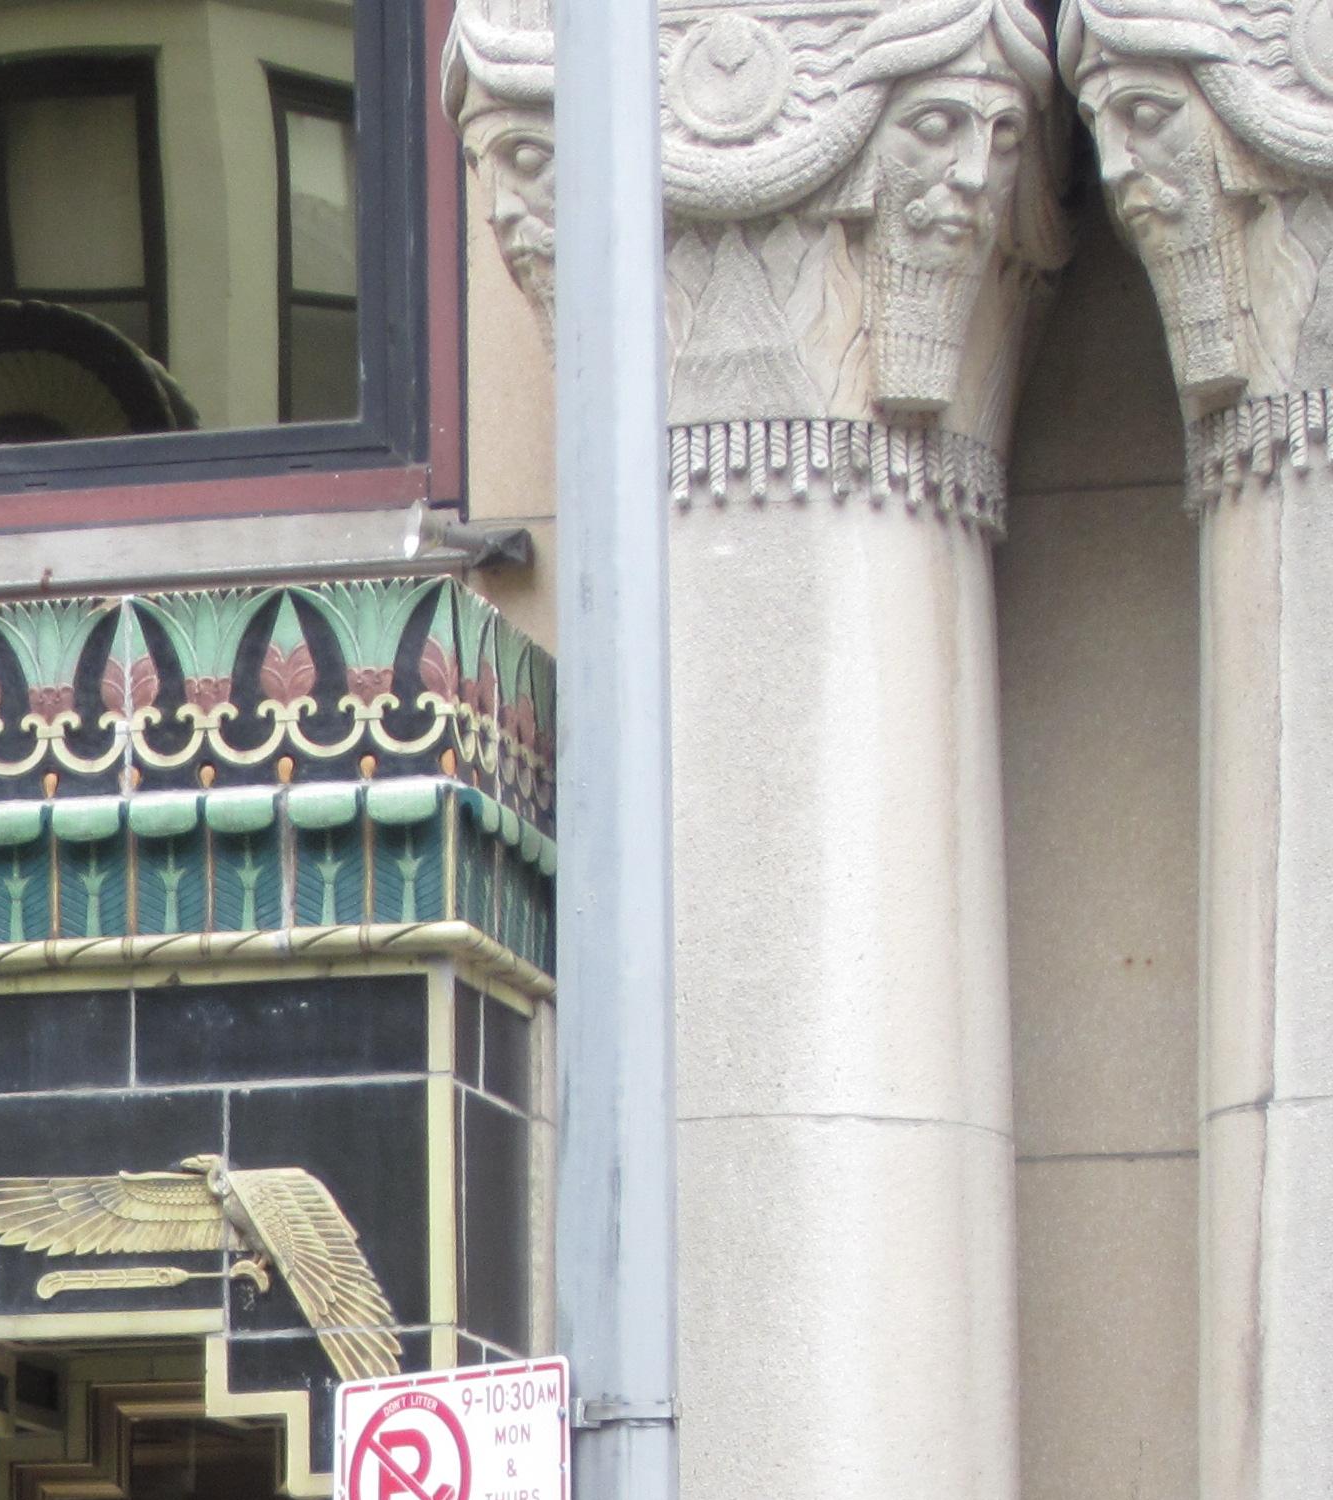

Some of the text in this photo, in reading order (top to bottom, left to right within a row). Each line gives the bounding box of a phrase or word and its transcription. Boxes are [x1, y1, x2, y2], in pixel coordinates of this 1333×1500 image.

[383, 1394, 439, 1418] DON'T LITTER
[494, 1423, 531, 1447] MON
[506, 1458, 518, 1478] &
